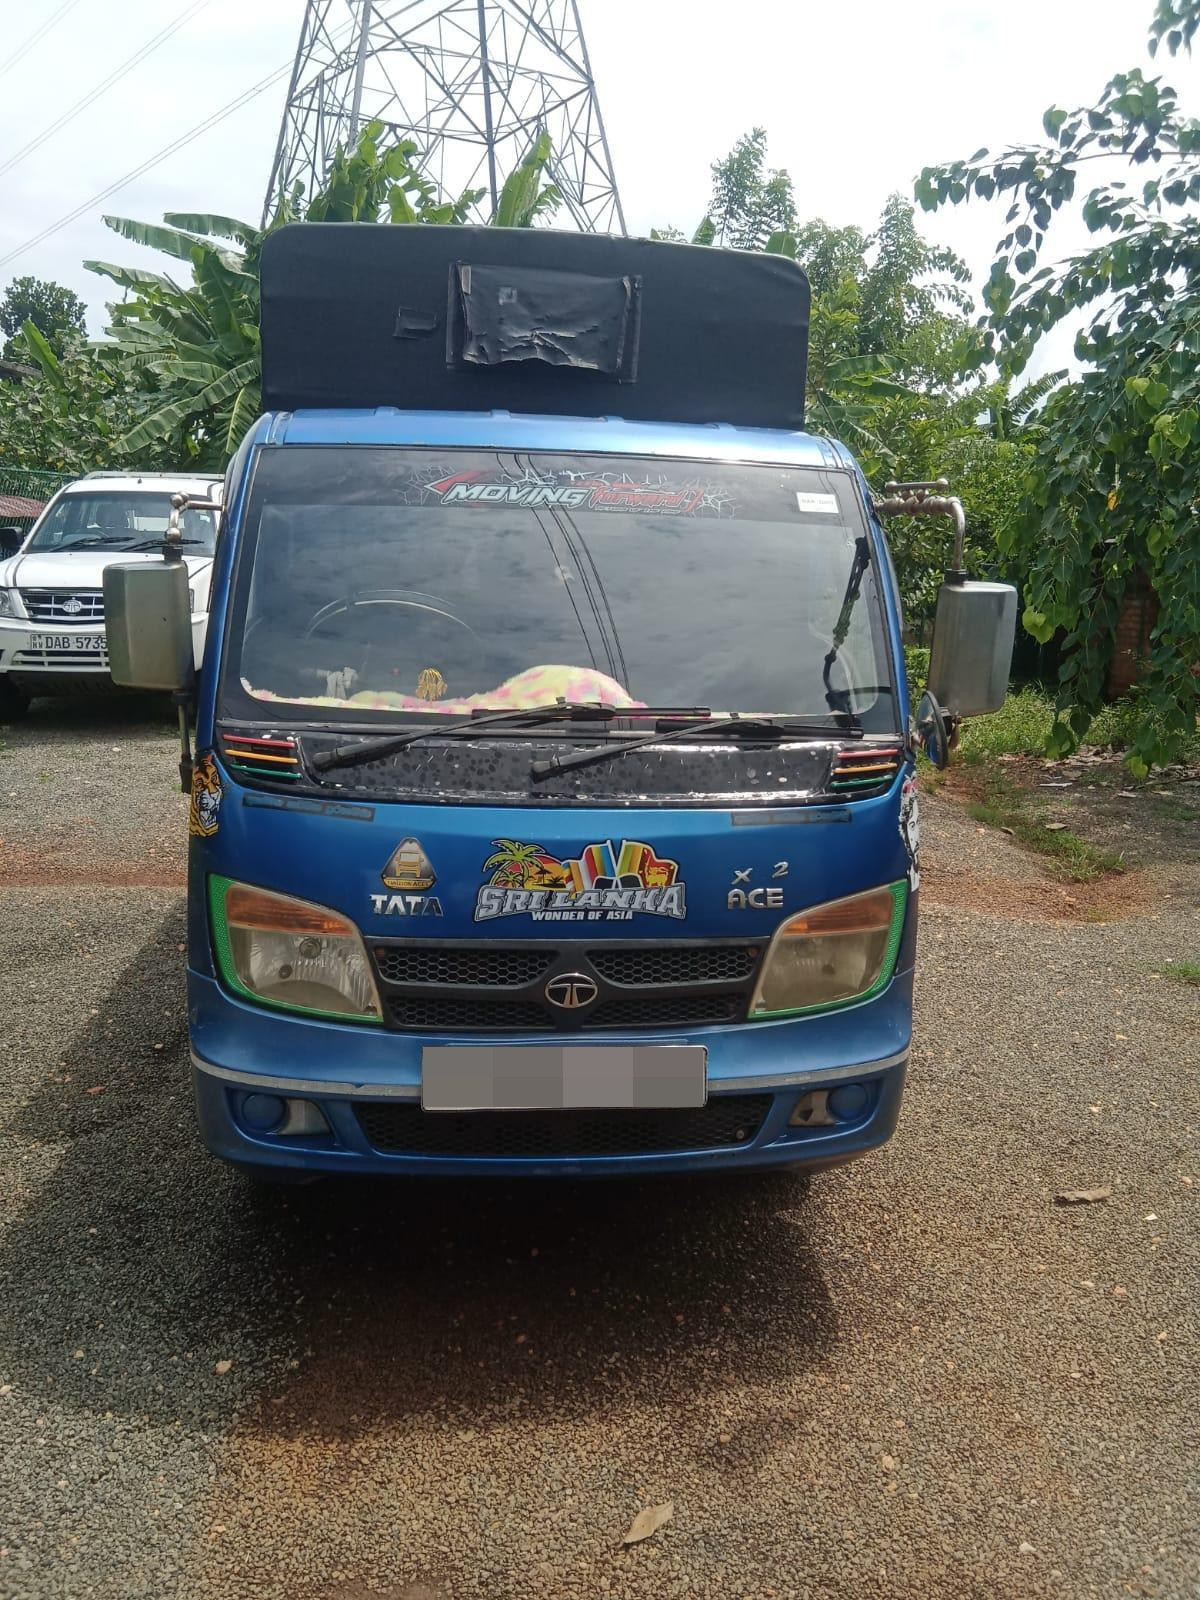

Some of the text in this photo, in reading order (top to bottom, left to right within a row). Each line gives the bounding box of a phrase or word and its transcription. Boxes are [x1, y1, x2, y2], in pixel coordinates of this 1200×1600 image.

[441, 483, 590, 508] MOVING
[45, 636, 108, 649] DAB 5735
[772, 861, 789, 878] 2
[370, 894, 443, 917] TATA
[475, 882, 687, 921] SRI LANKA
[728, 888, 784, 909] ACE
[532, 910, 633, 921] WONDER OF ASIA
